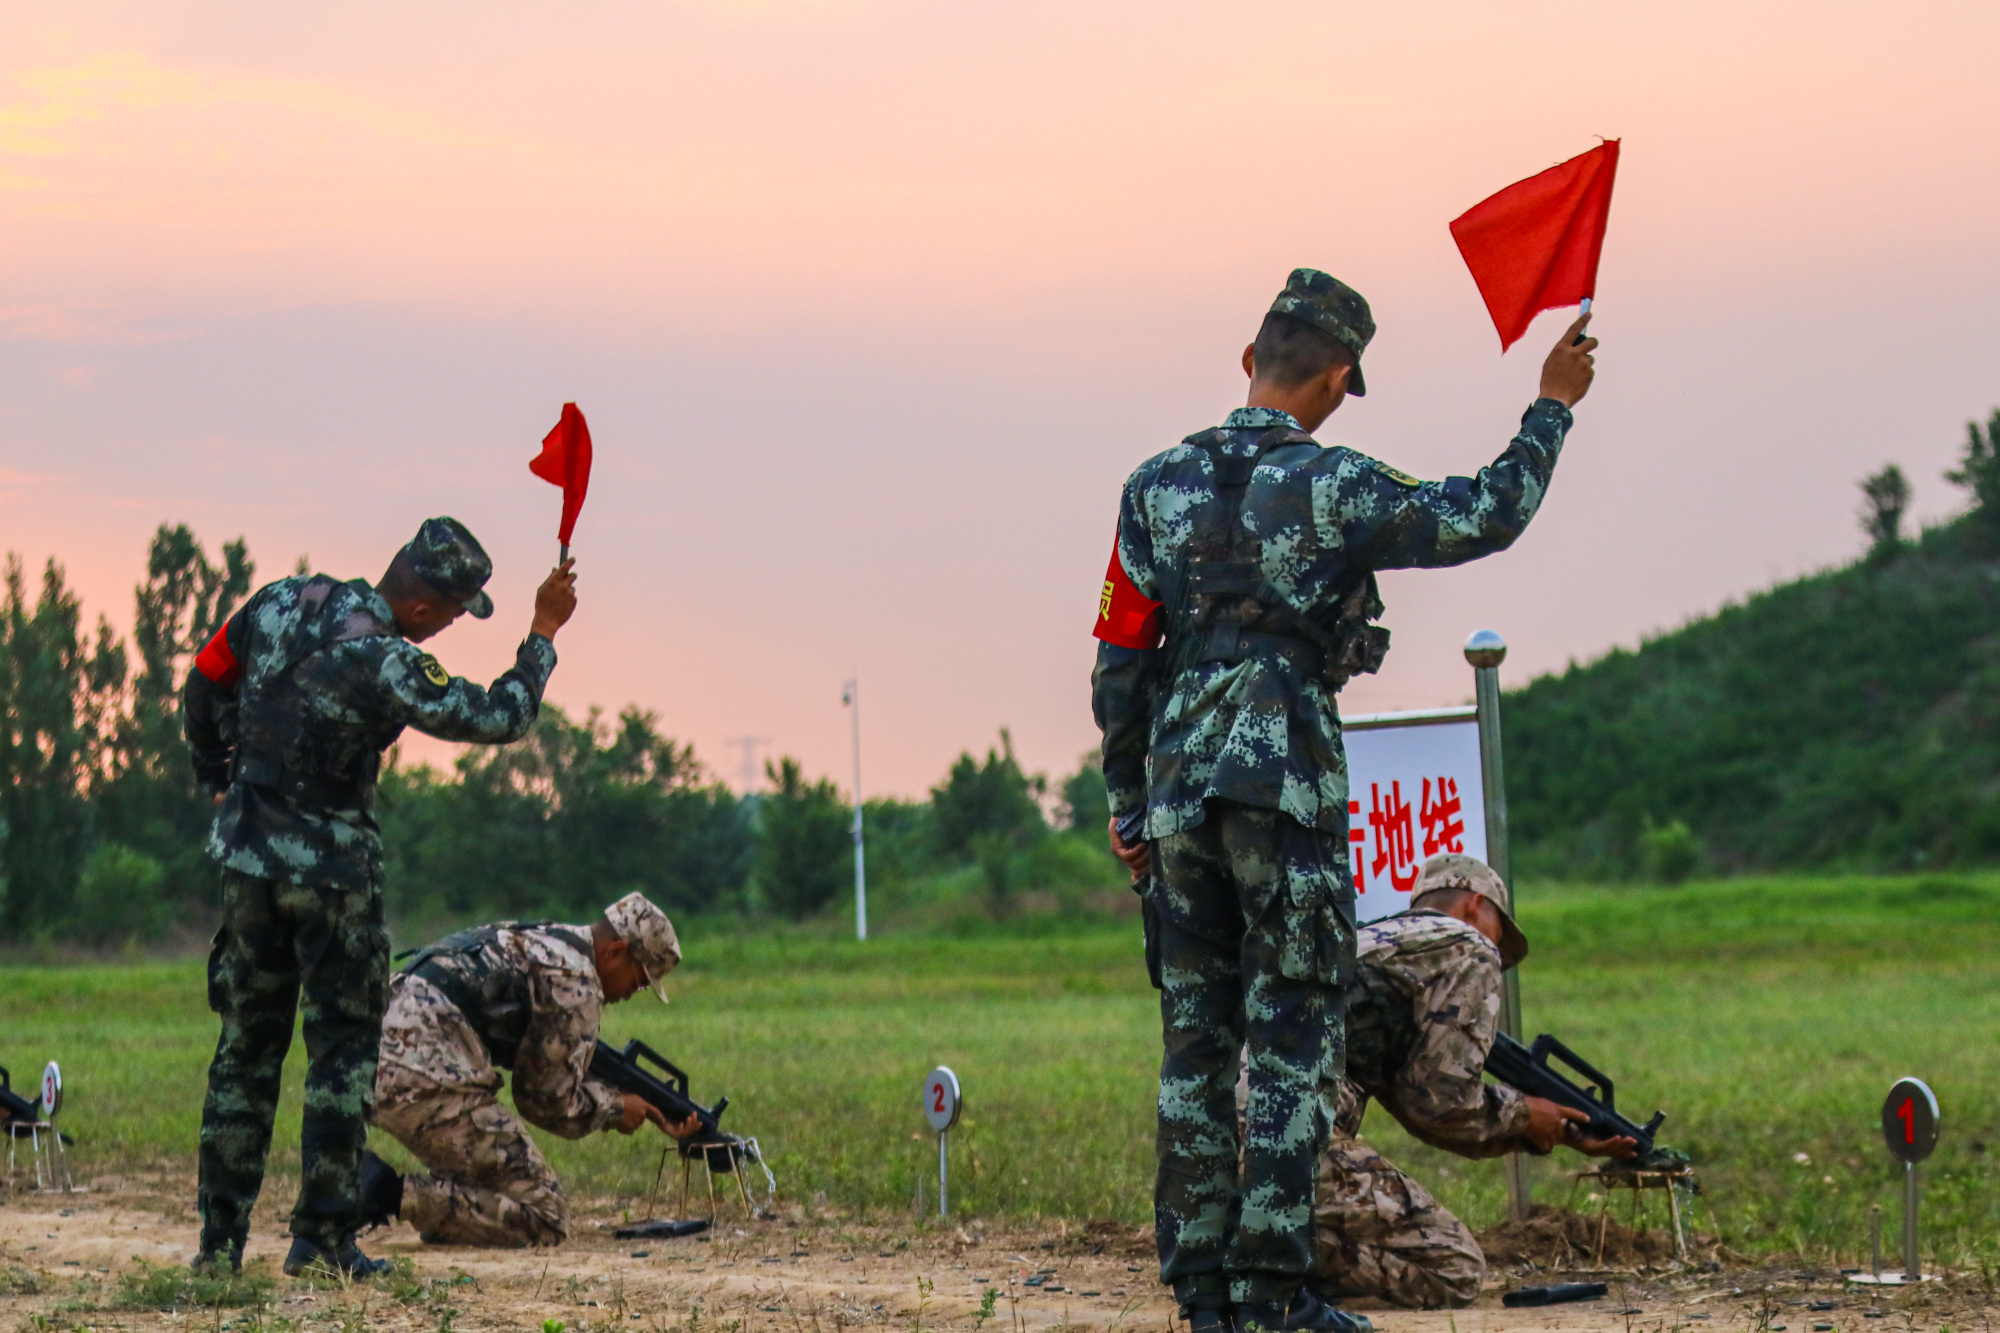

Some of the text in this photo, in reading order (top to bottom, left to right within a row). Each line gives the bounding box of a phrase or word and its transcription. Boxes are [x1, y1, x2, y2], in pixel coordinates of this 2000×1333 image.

[46, 1075, 53, 1104] 3
[933, 1083, 945, 1112] 2
[1897, 1097, 1915, 1144] 1
